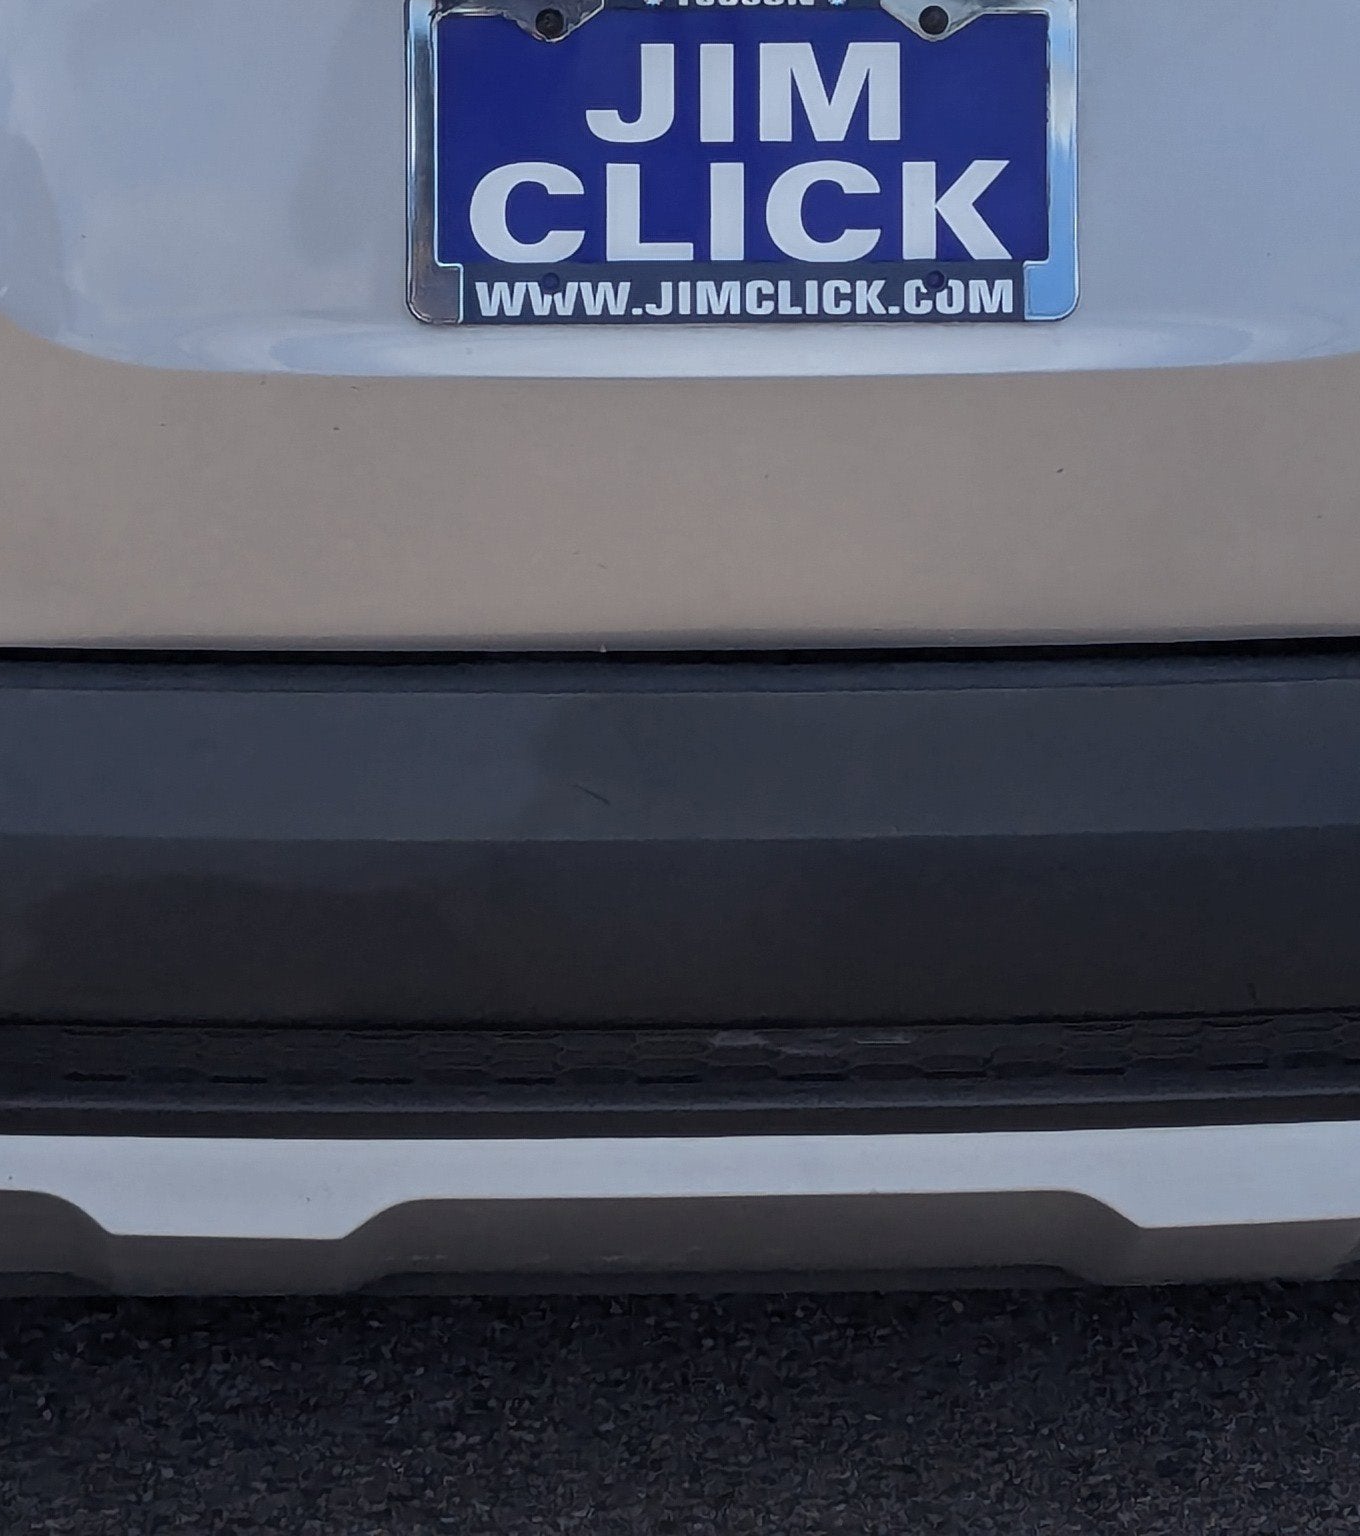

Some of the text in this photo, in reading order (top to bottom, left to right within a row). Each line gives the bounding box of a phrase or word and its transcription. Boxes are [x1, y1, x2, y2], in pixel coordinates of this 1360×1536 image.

[586, 41, 901, 143] JIM
[469, 160, 1013, 263] CLICK
[475, 279, 1014, 316] WWW.JIMCLICK.COM
